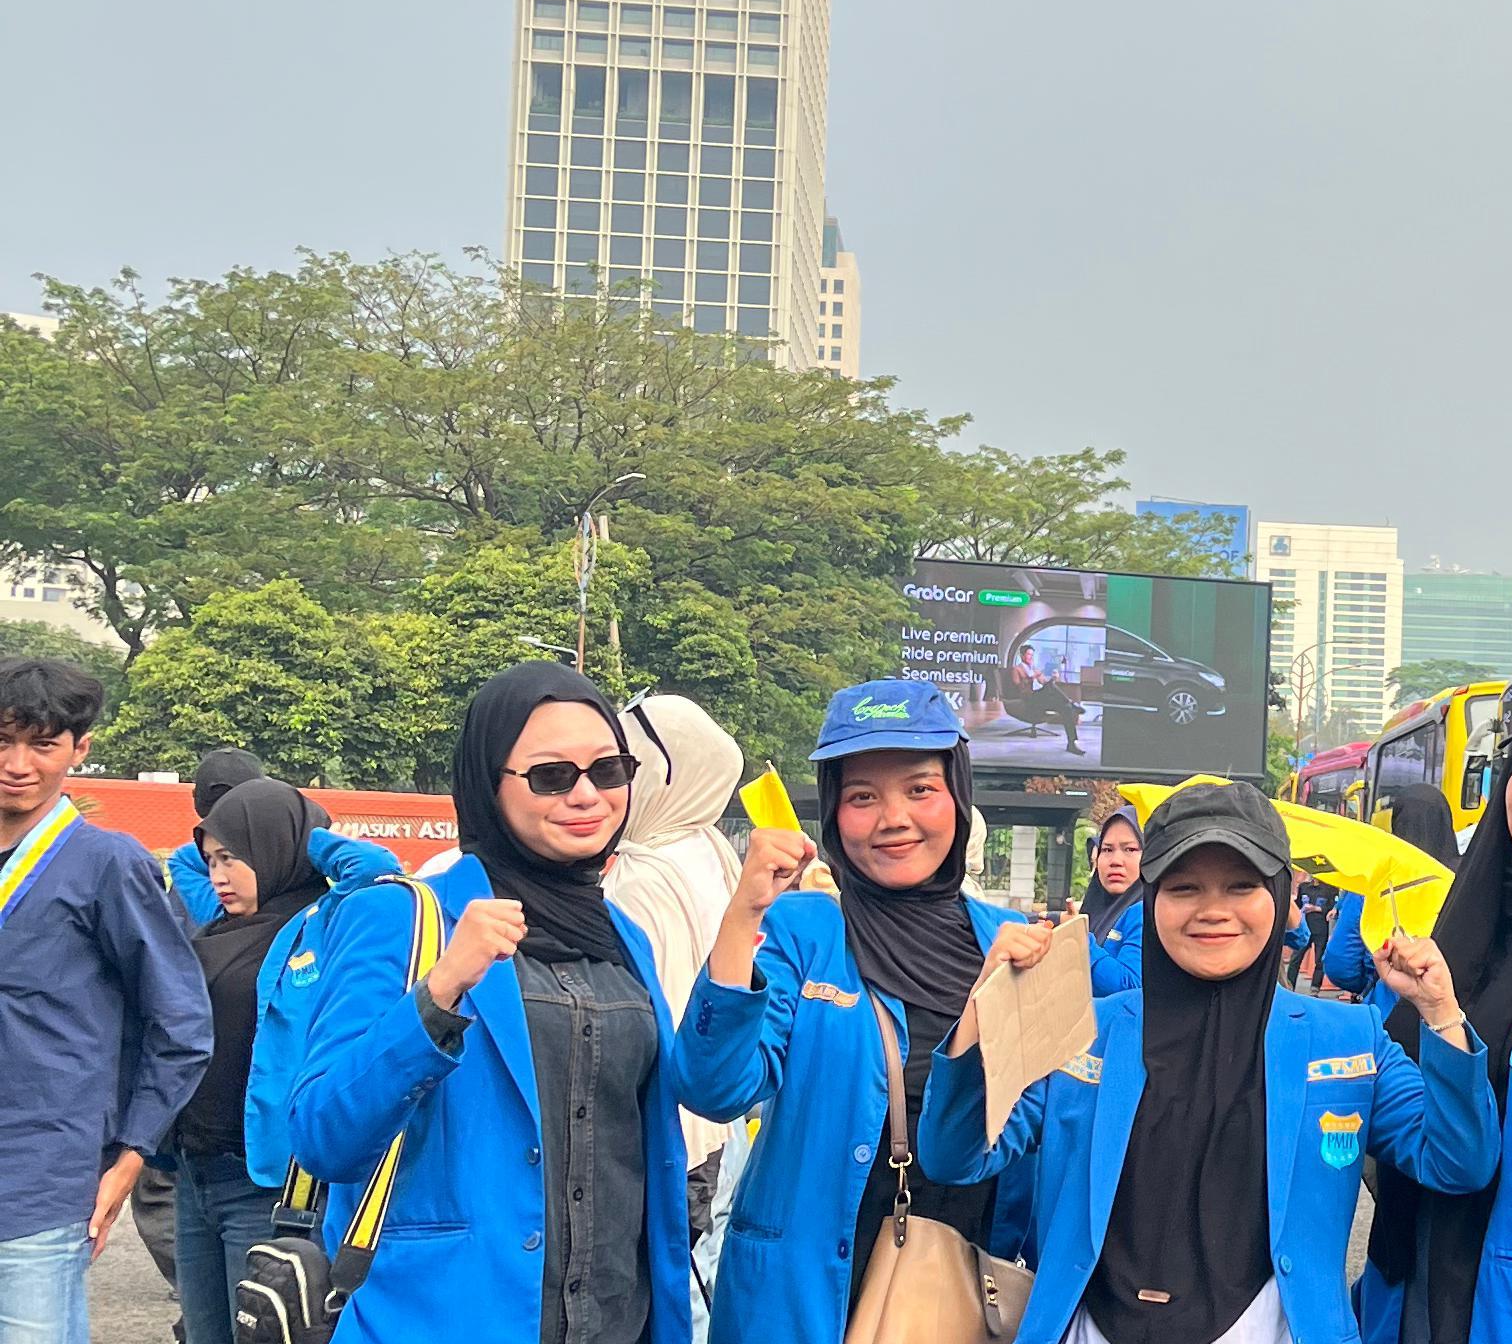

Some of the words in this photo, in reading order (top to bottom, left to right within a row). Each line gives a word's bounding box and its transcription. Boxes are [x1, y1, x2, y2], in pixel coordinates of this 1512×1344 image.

[903, 583, 974, 603] GrabCar
[985, 593, 1022, 603] Premium
[901, 627, 931, 640] Live
[934, 629, 999, 645] premium.
[901, 646, 934, 661] Ride
[936, 650, 1002, 665] premium.
[1327, 1133, 1354, 1149] PMII
